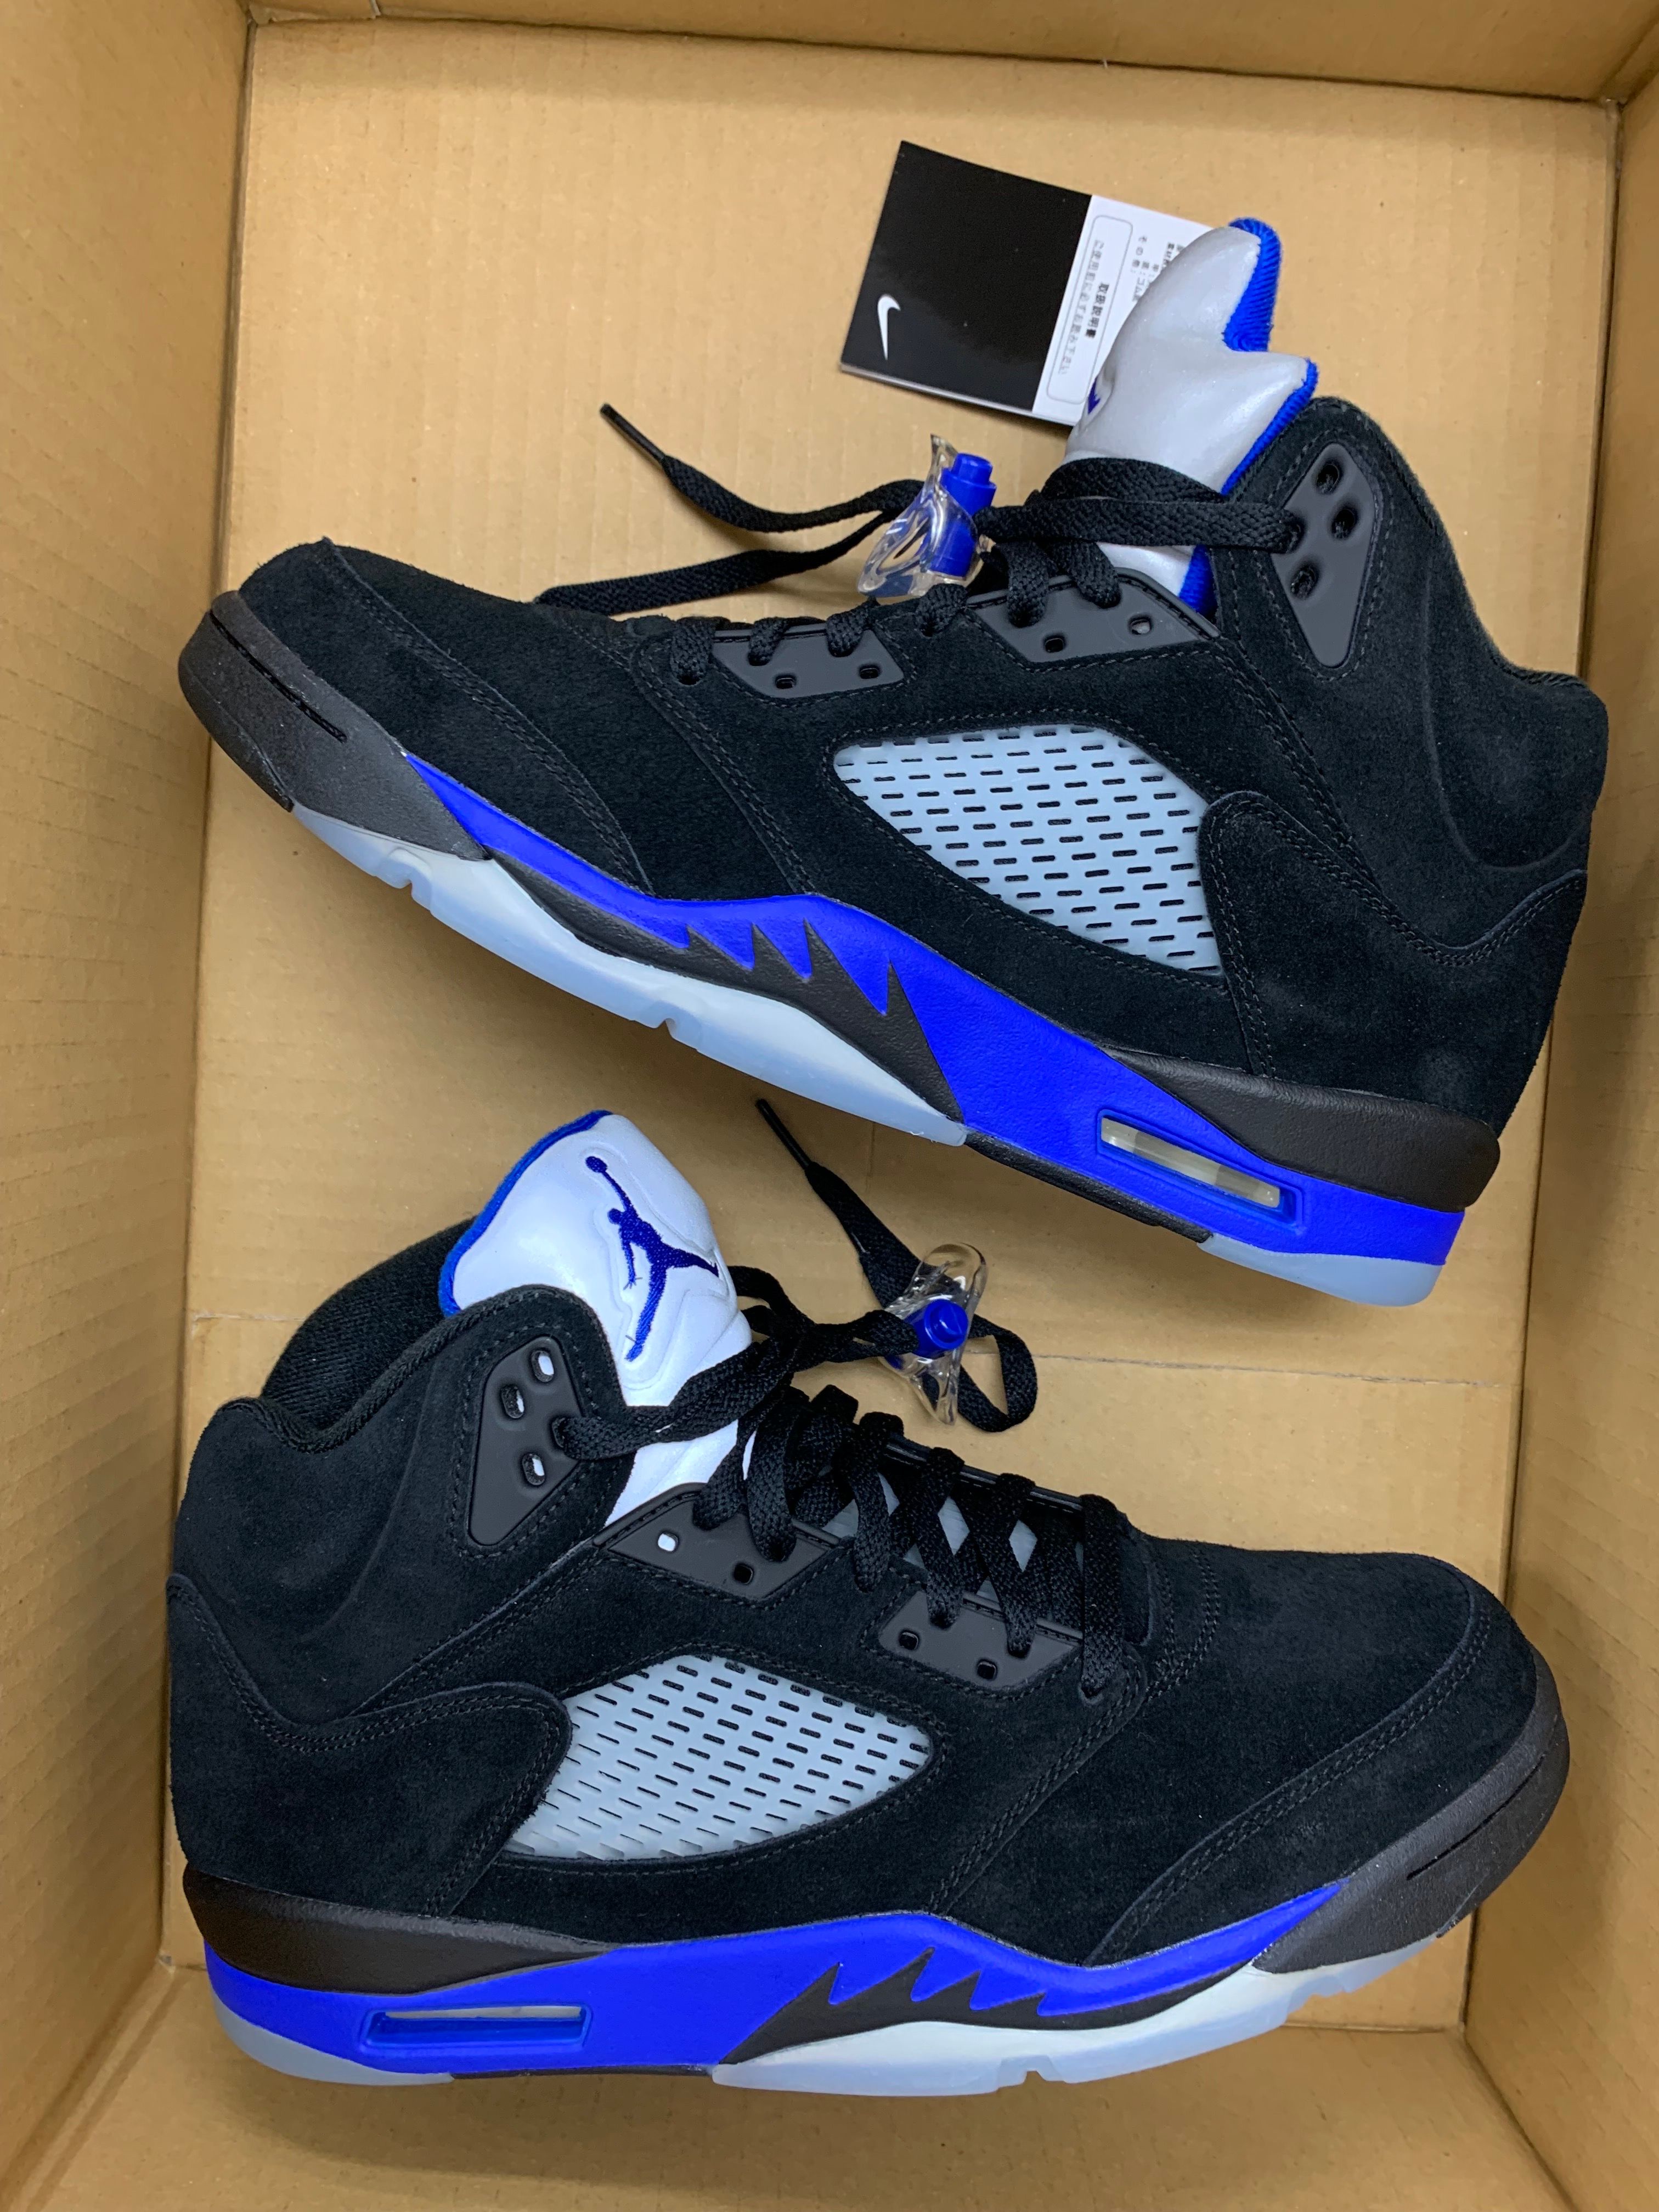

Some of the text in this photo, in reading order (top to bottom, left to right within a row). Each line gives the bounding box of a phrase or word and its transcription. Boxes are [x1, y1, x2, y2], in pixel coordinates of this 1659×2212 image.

[1085, 282, 1109, 338] 取扱説明書
